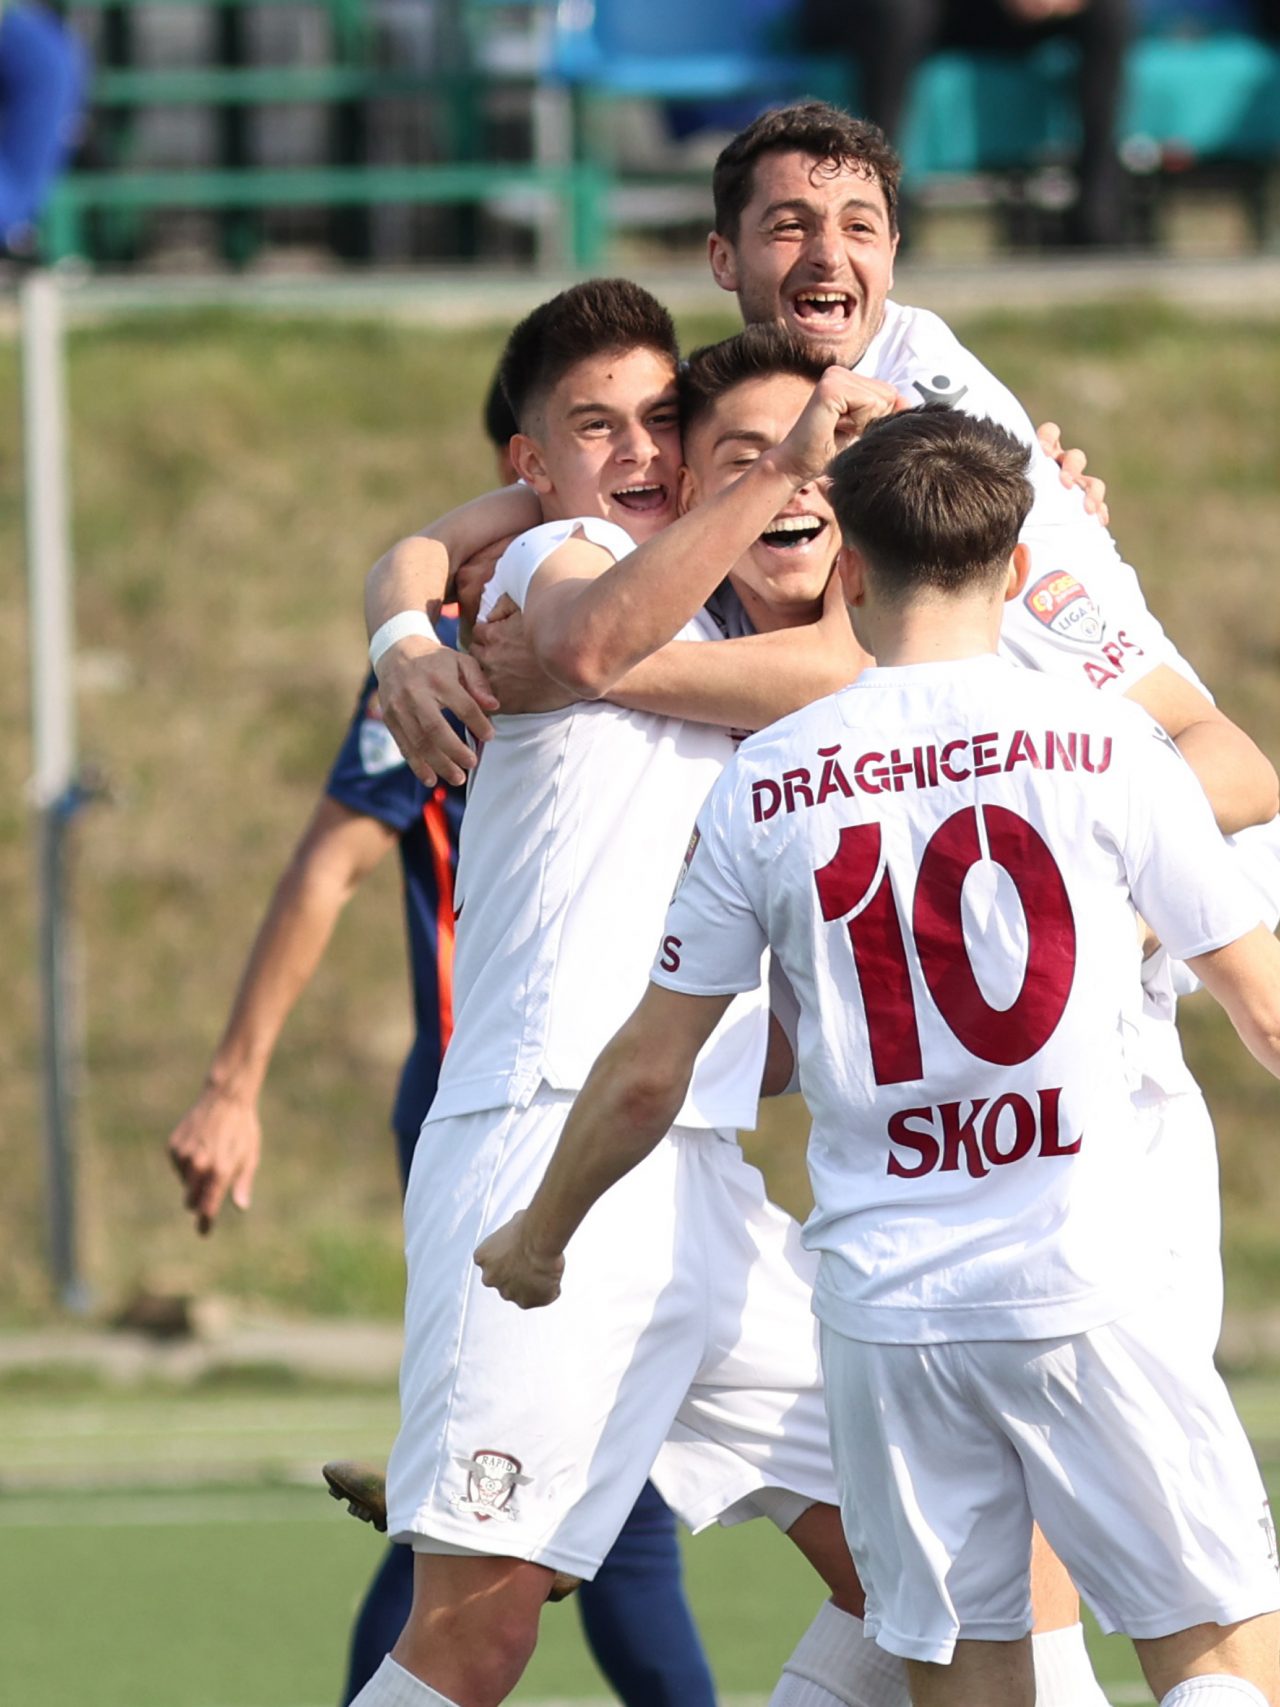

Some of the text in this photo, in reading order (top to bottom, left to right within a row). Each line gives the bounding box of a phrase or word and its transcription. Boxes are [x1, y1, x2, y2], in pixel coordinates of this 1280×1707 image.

[1058, 607, 1088, 630] LIGA
[751, 729, 1113, 824] DRĂGHICEANU
[814, 803, 1077, 1087] 10
[886, 1086, 1085, 1179] SKOL
[481, 1455, 514, 1472] RAPID
